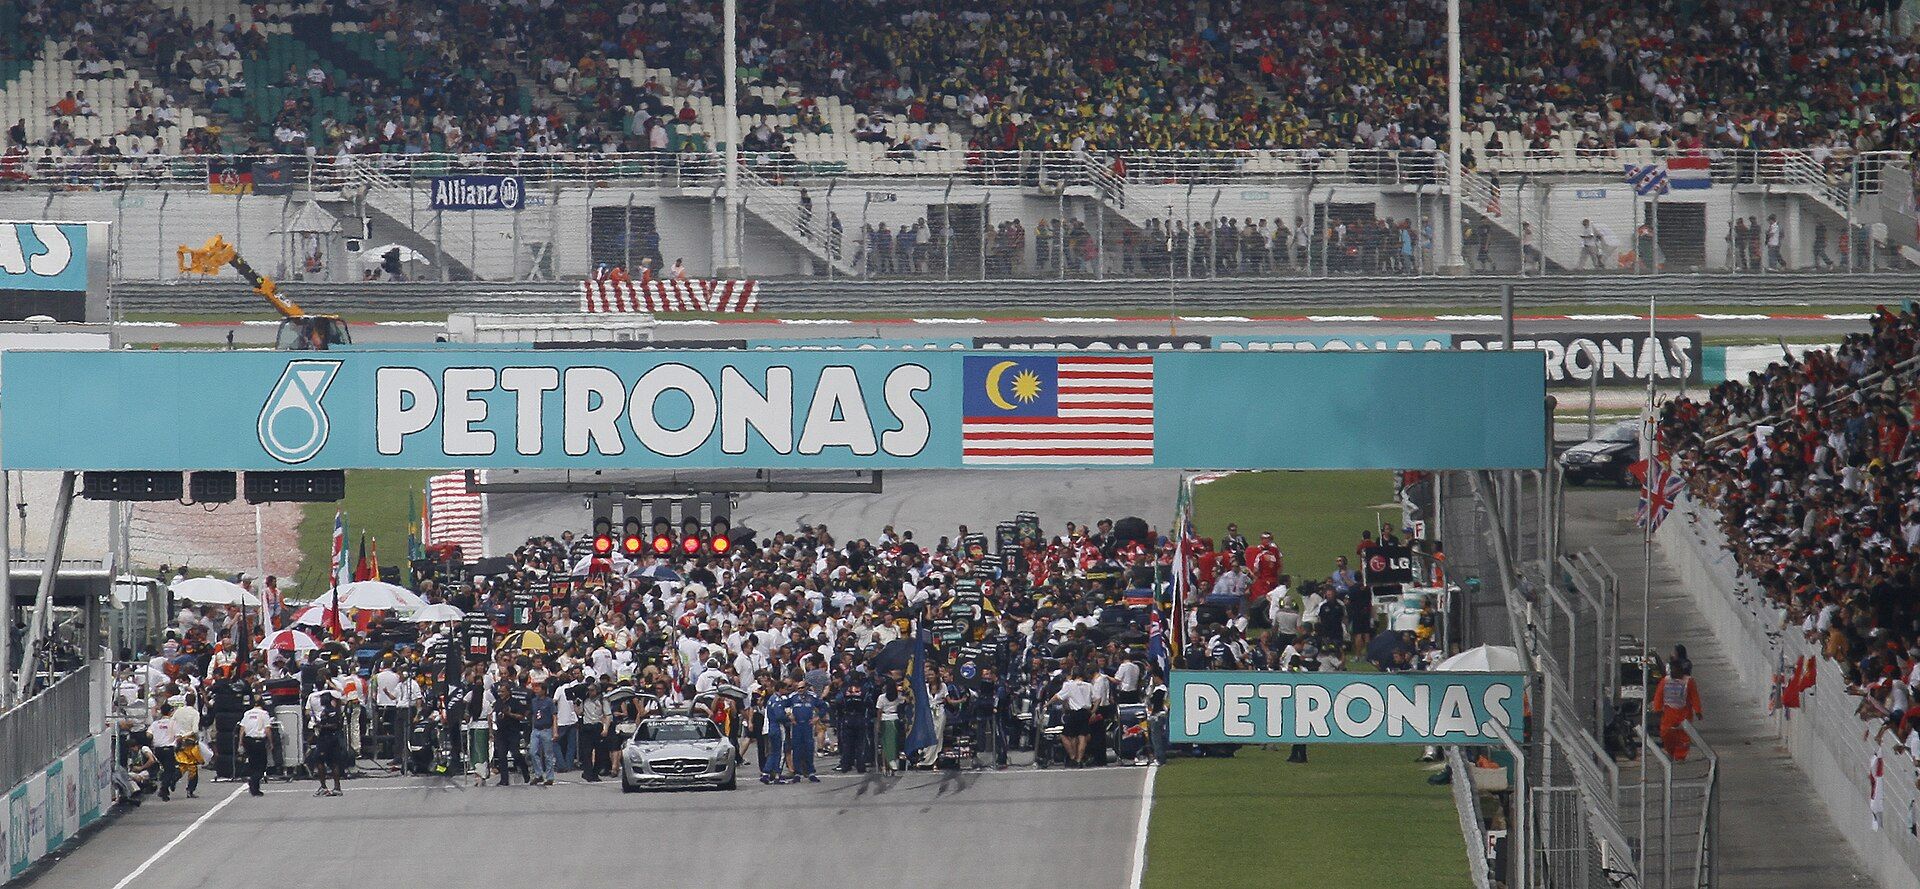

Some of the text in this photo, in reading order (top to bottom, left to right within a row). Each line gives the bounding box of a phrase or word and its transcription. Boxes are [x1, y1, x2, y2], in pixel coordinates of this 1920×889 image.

[435, 178, 499, 206] Allianz
[376, 363, 933, 457] PETRONAS
[1389, 556, 1411, 570] LG
[1183, 682, 1513, 738] PETRONAS
